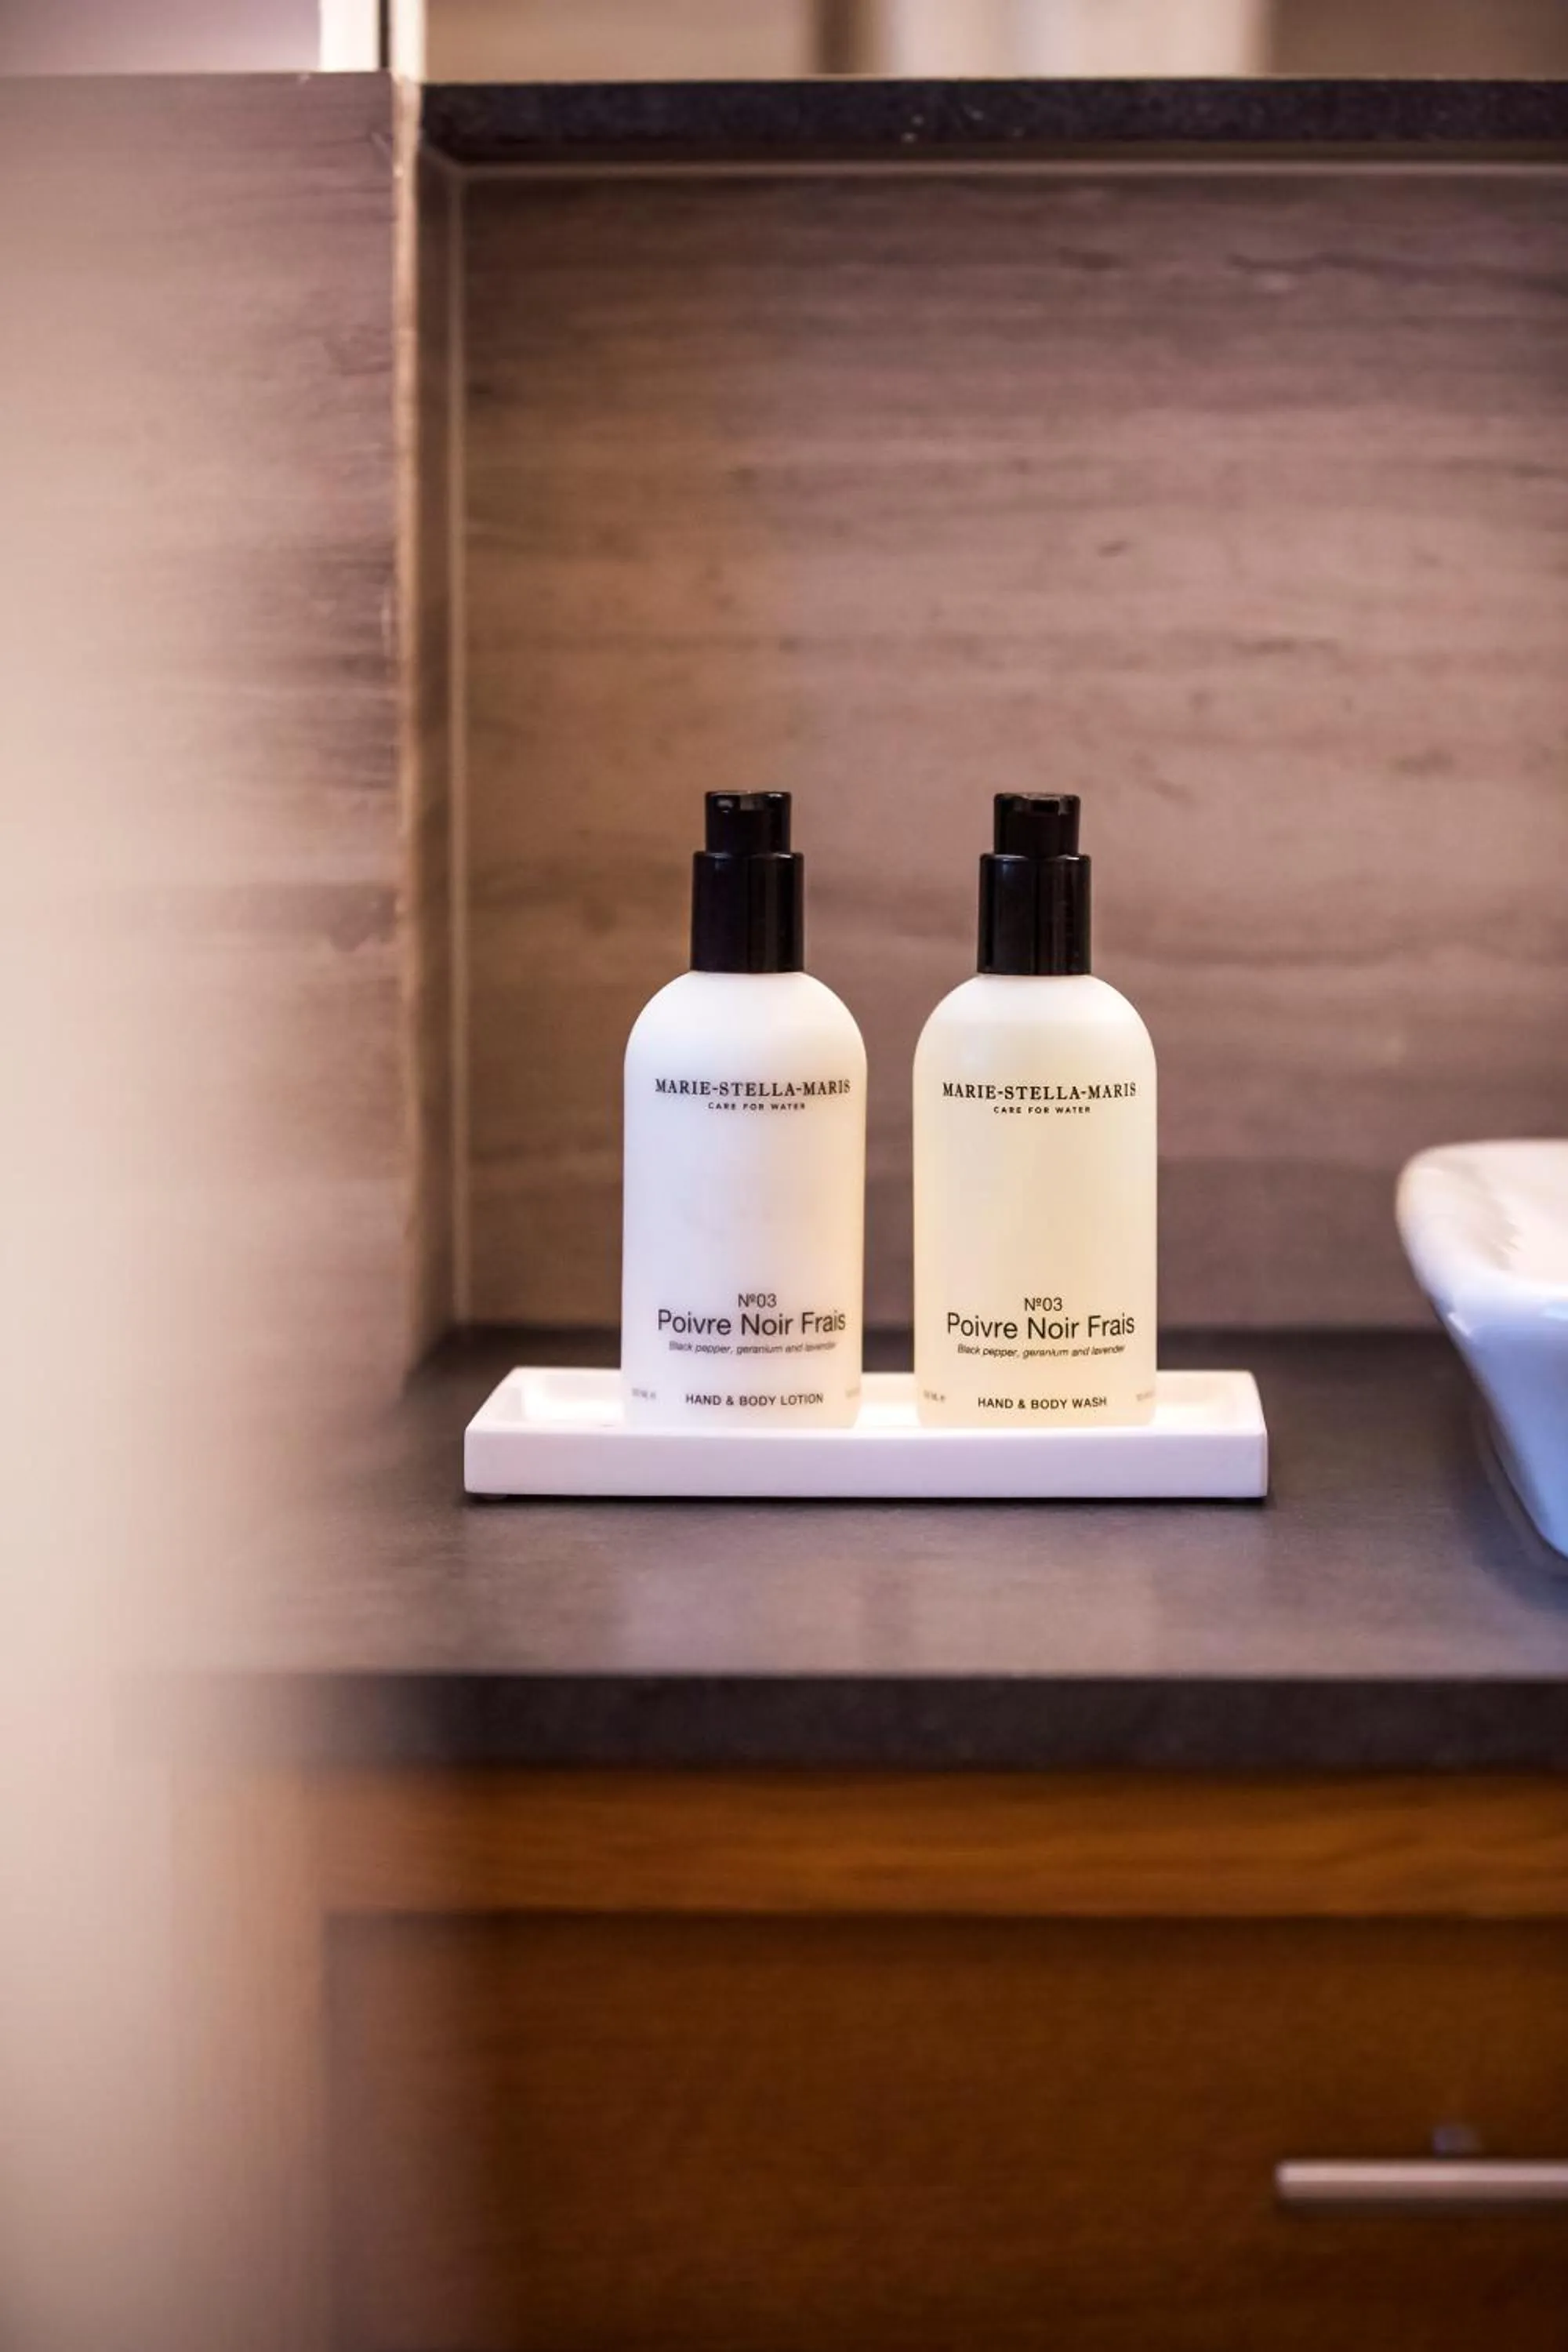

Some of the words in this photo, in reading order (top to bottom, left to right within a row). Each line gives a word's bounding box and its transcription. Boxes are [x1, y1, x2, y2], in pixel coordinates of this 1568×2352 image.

[655, 1078, 851, 1097] MARIE-STELLA-MARIS
[942, 1081, 1137, 1100] MARIE-STELLA-MARIS
[708, 1102, 736, 1110] CARE
[657, 1308, 731, 1336] Poivre
[741, 1313, 794, 1336] Noir
[801, 1310, 846, 1334] Frais
[946, 1312, 1018, 1339] Poivre
[1027, 1316, 1080, 1339] Noir
[1087, 1312, 1135, 1338] Frais
[956, 1343, 981, 1356] Black
[686, 1394, 722, 1406] HAND
[725, 1396, 735, 1406] &
[739, 1395, 777, 1406] BODY
[780, 1392, 823, 1406] LOTION
[978, 1397, 1014, 1409] HAND
[1018, 1398, 1026, 1409] &
[1030, 1398, 1068, 1410] BODY
[1071, 1396, 1108, 1409] WASH
